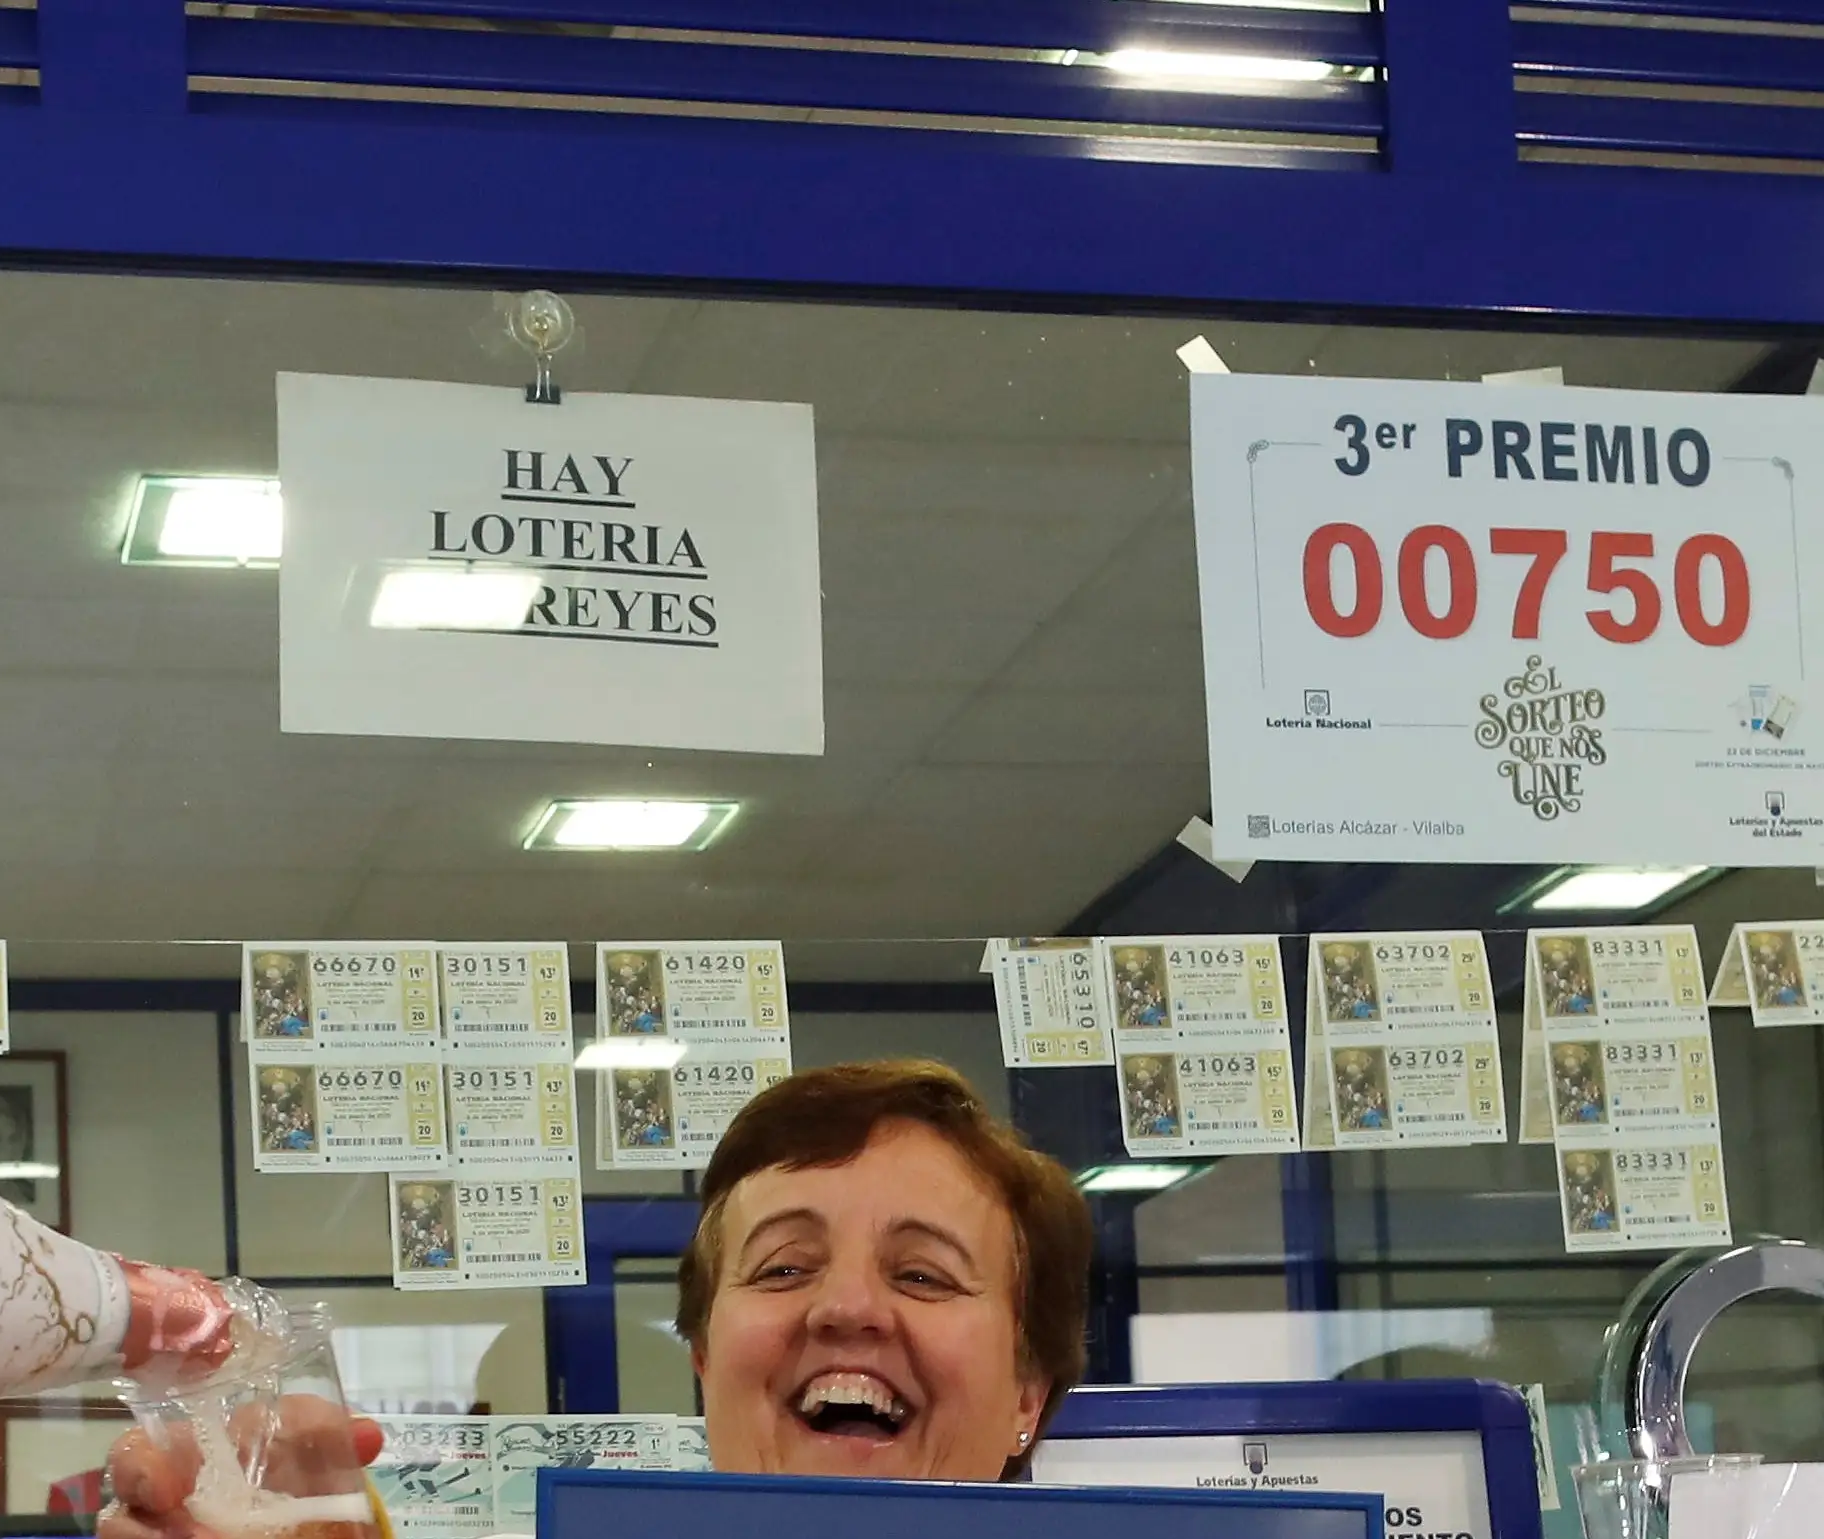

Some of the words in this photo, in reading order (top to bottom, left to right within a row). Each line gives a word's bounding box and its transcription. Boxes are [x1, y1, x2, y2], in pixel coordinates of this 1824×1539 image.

[1333, 414, 1417, 476] 3er
[1445, 418, 1711, 487] PREMIO
[502, 449, 634, 497] HAY
[429, 510, 706, 569] LOTERIA
[1302, 522, 1751, 647] 00750
[1504, 654, 1562, 699] EL
[1316, 717, 1372, 730] Nacional
[1474, 688, 1606, 750] SORTEO
[1509, 736, 1554, 763] QUE
[1560, 723, 1607, 766] NOS
[1412, 819, 1465, 837] Vilalba
[1769, 828, 1803, 838] Estado
[1376, 945, 1450, 960] 63702
[1592, 939, 1663, 956] 83331
[313, 957, 396, 973] 66670
[447, 957, 527, 974] 30151
[665, 955, 745, 971] 61420
[1169, 949, 1245, 965] 41063
[1072, 952, 1095, 1029] 65310
[1389, 1050, 1464, 1066] 63702
[1607, 1044, 1677, 1061] 83331
[1179, 1057, 1256, 1073] 41063
[319, 1070, 402, 1087] 66670
[453, 1071, 533, 1088] 30151
[674, 1066, 754, 1082] 61420
[1616, 1152, 1687, 1169] 83331
[459, 1186, 539, 1203] 30151
[402, 1429, 485, 1446] 03233
[556, 1429, 637, 1447] 55222
[603, 1449, 639, 1459] Jueves
[1250, 1478, 1258, 1490] y
[1261, 1474, 1319, 1488] Apuestas
